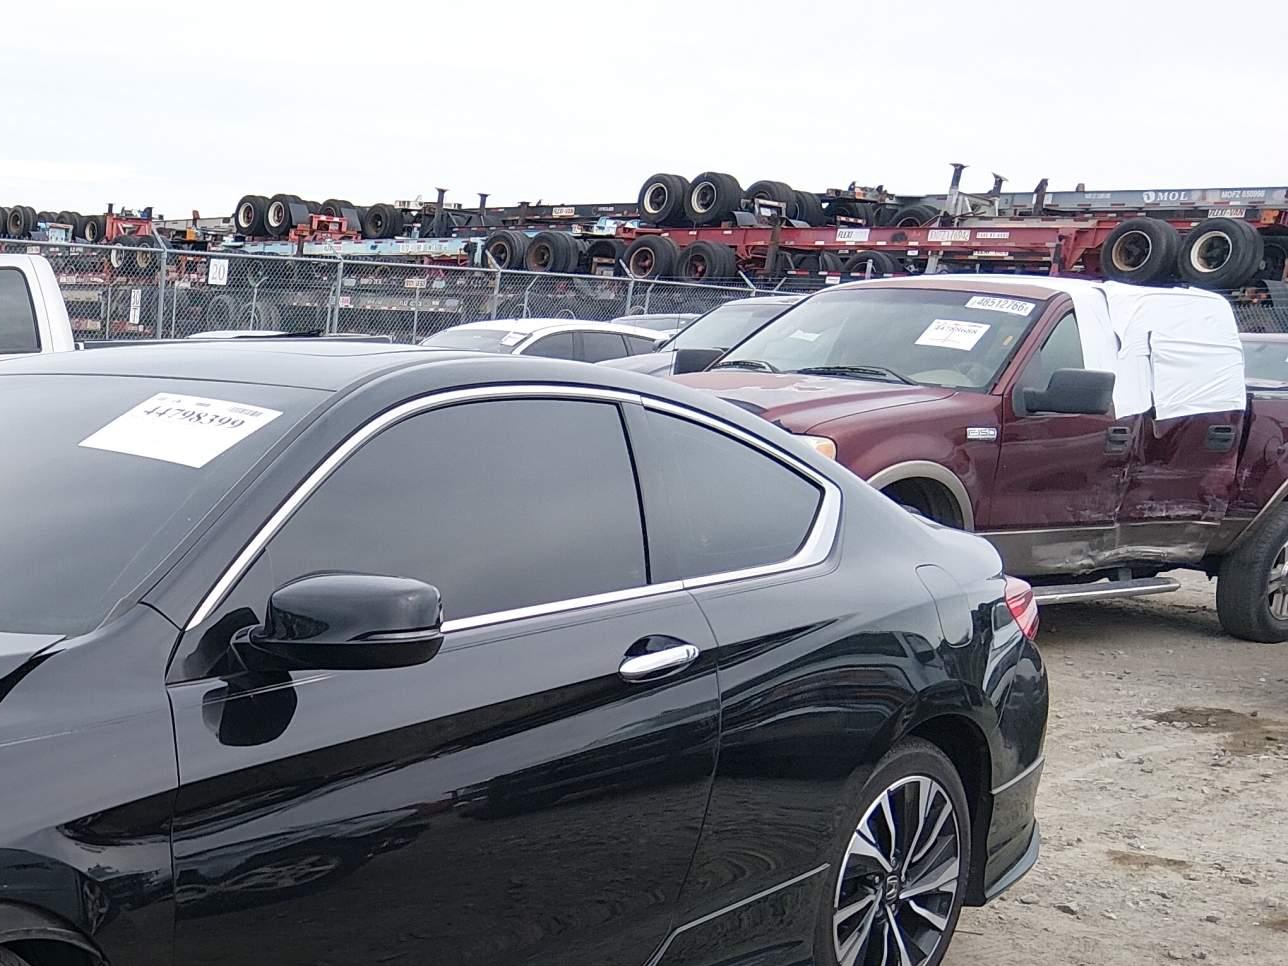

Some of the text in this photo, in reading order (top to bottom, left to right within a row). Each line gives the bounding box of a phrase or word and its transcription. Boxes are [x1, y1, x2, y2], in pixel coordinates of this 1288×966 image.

[1157, 191, 1189, 201] MOL
[211, 263, 226, 281] 20
[143, 405, 246, 429] 44798399
